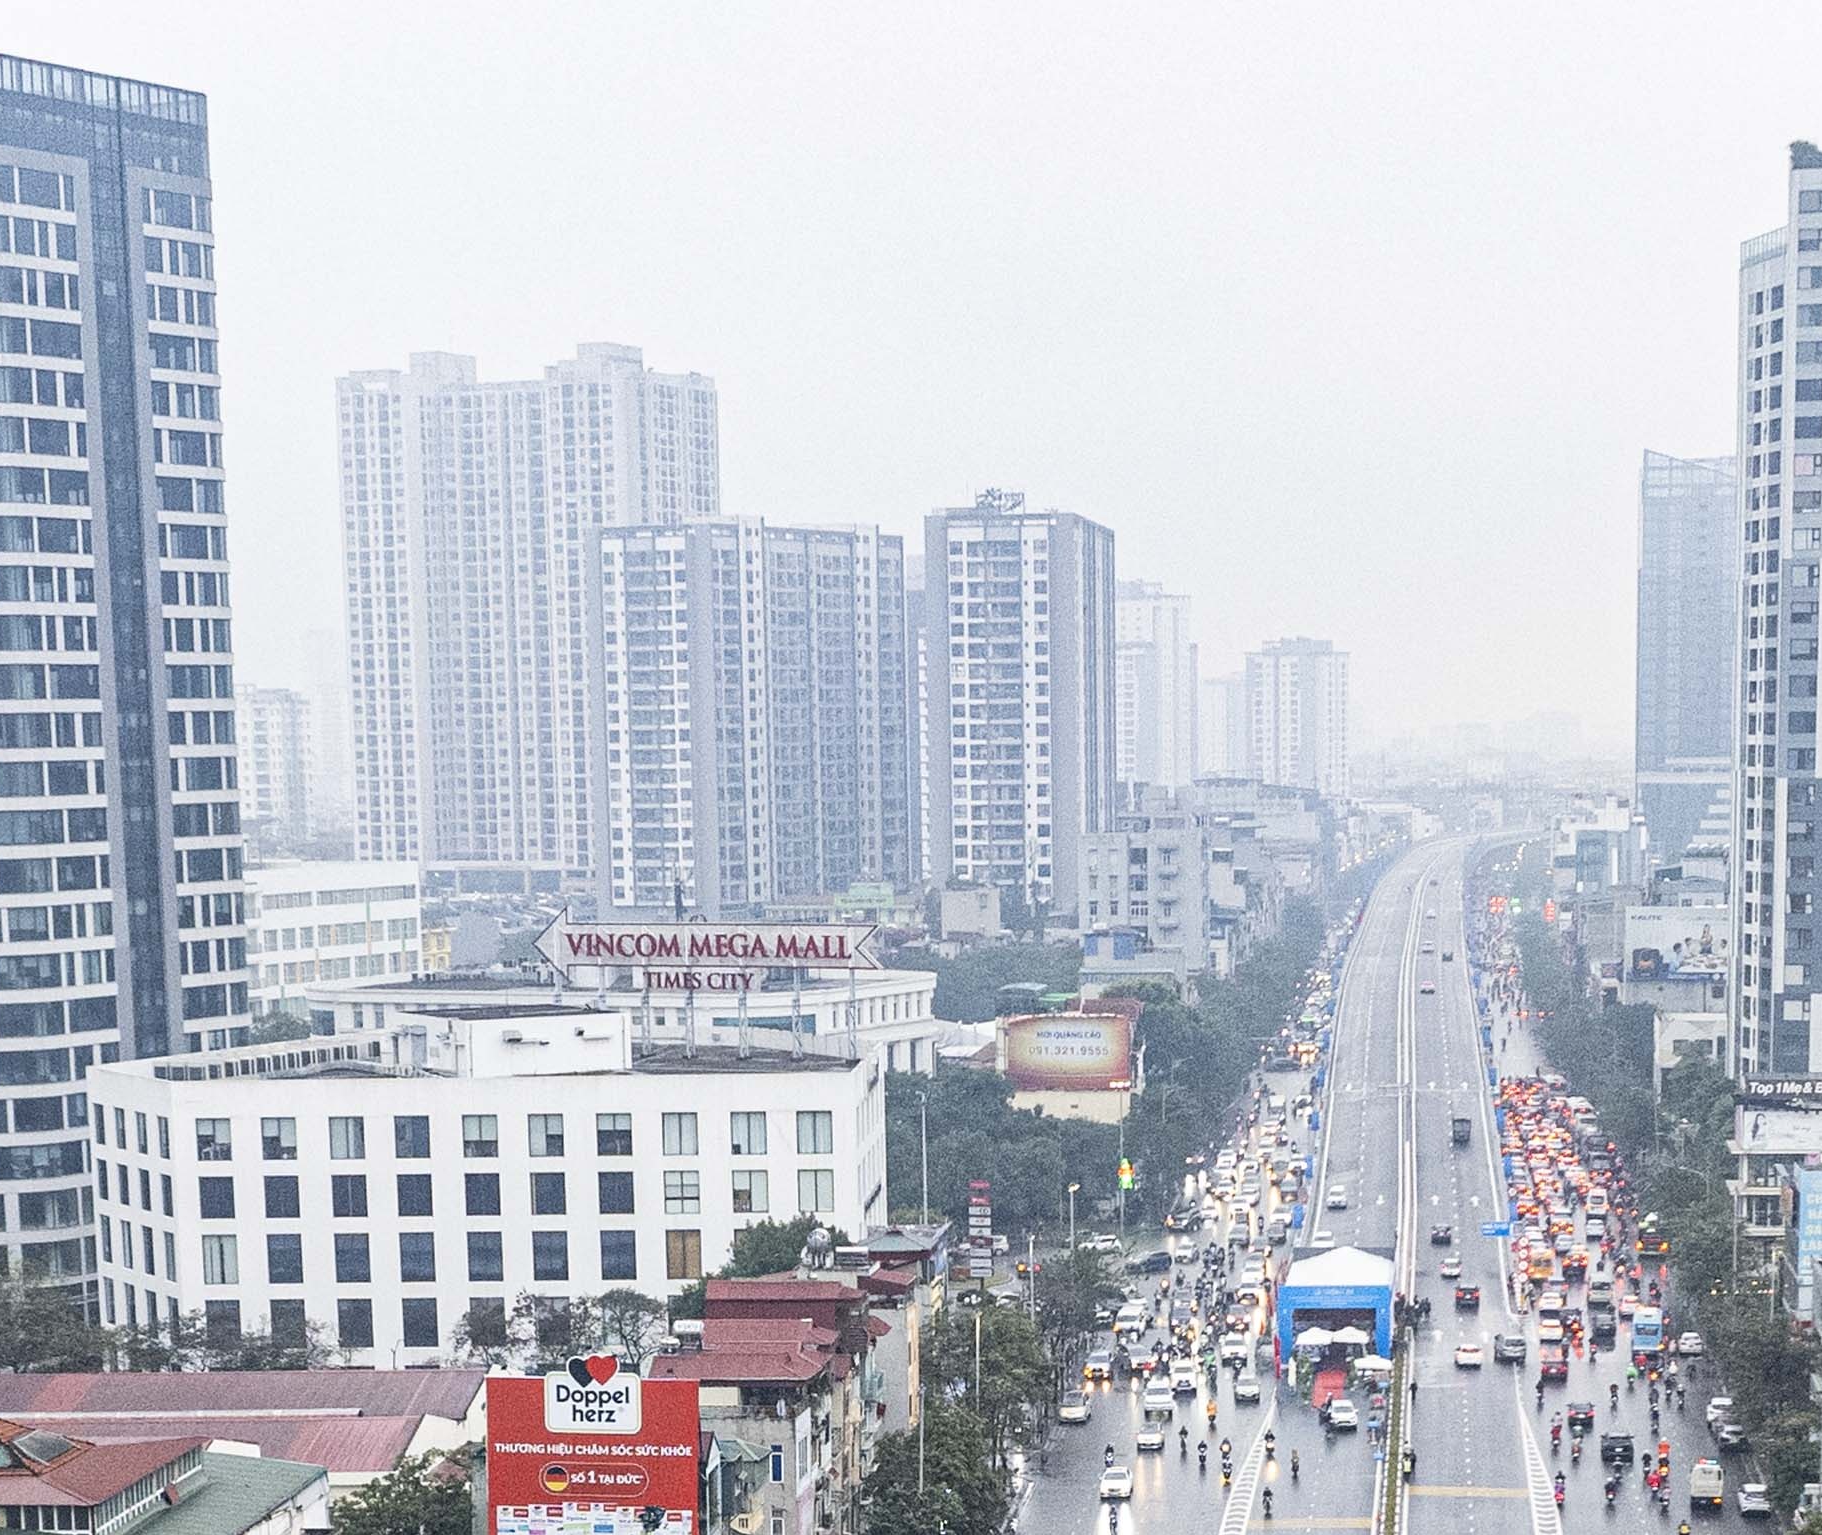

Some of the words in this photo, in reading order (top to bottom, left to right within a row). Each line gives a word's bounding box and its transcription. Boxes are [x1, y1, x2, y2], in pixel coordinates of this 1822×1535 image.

[565, 933, 682, 959] VINCOM
[687, 933, 772, 959] MEGA
[774, 933, 852, 960] MALL
[643, 971, 701, 990] TIMES
[706, 972, 754, 991] CITY
[1748, 1081, 1774, 1096] Top
[1782, 1081, 1803, 1095] Mẹ
[1802, 1081, 1813, 1094] &
[556, 1384, 630, 1408] Doppel
[572, 1404, 616, 1423] herz
[495, 1442, 546, 1454] THƯƠNG
[546, 1443, 573, 1457] HIỆU
[575, 1442, 609, 1456] CHĂM
[611, 1442, 635, 1456] SÓC
[635, 1442, 659, 1457] SỨC
[570, 1473, 586, 1483] SỐ
[587, 1471, 596, 1482] 1
[598, 1474, 615, 1486] TẠI
